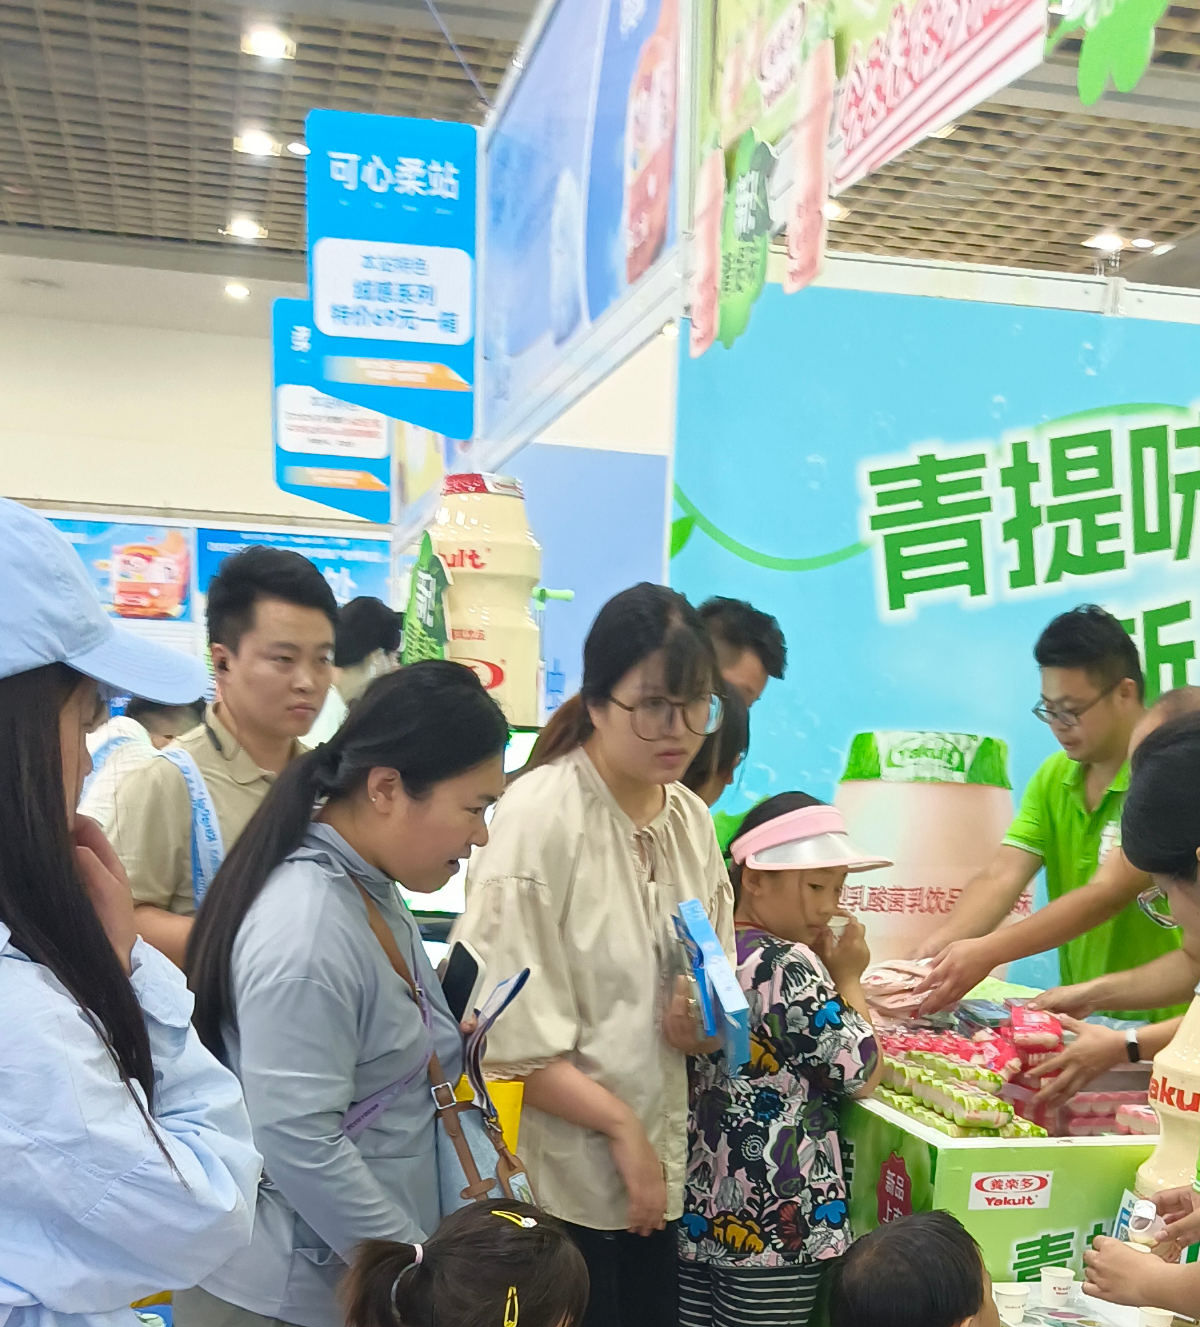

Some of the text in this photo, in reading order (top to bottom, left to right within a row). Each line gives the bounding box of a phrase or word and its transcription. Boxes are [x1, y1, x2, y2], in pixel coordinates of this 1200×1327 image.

[327, 151, 460, 200] 可心柔站
[984, 1195, 1036, 1207] Yakult
